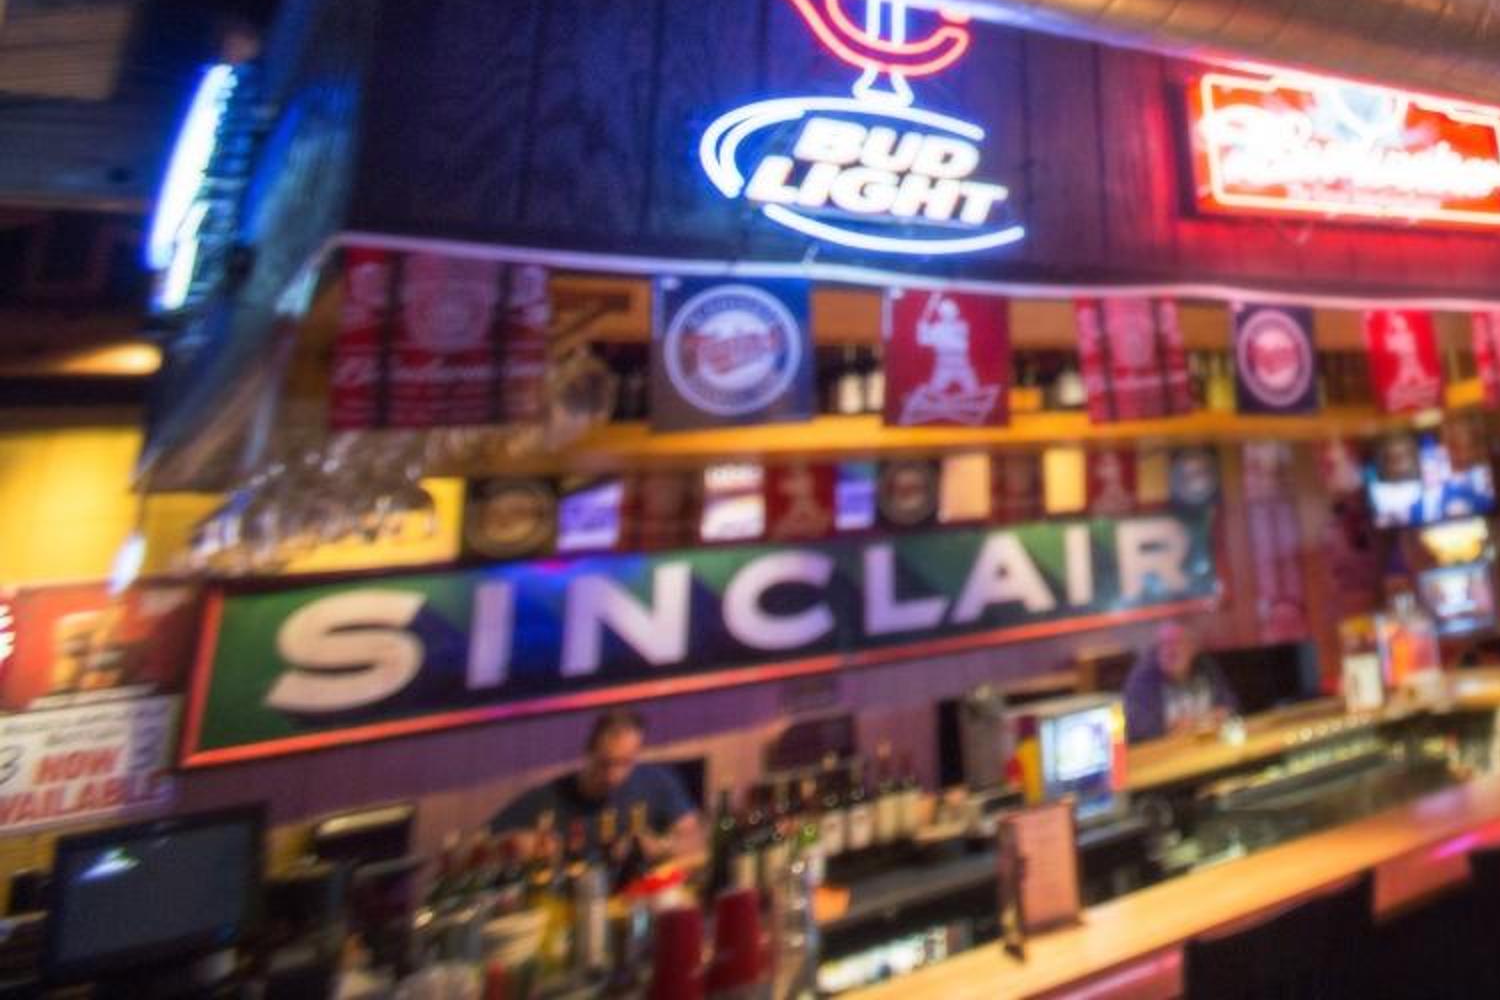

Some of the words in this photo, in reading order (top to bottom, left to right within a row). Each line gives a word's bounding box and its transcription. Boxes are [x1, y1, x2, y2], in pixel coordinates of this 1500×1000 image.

[794, 118, 980, 179] BUD
[745, 156, 1008, 225] LIGHT
[264, 516, 1192, 712] SINCLAIR
